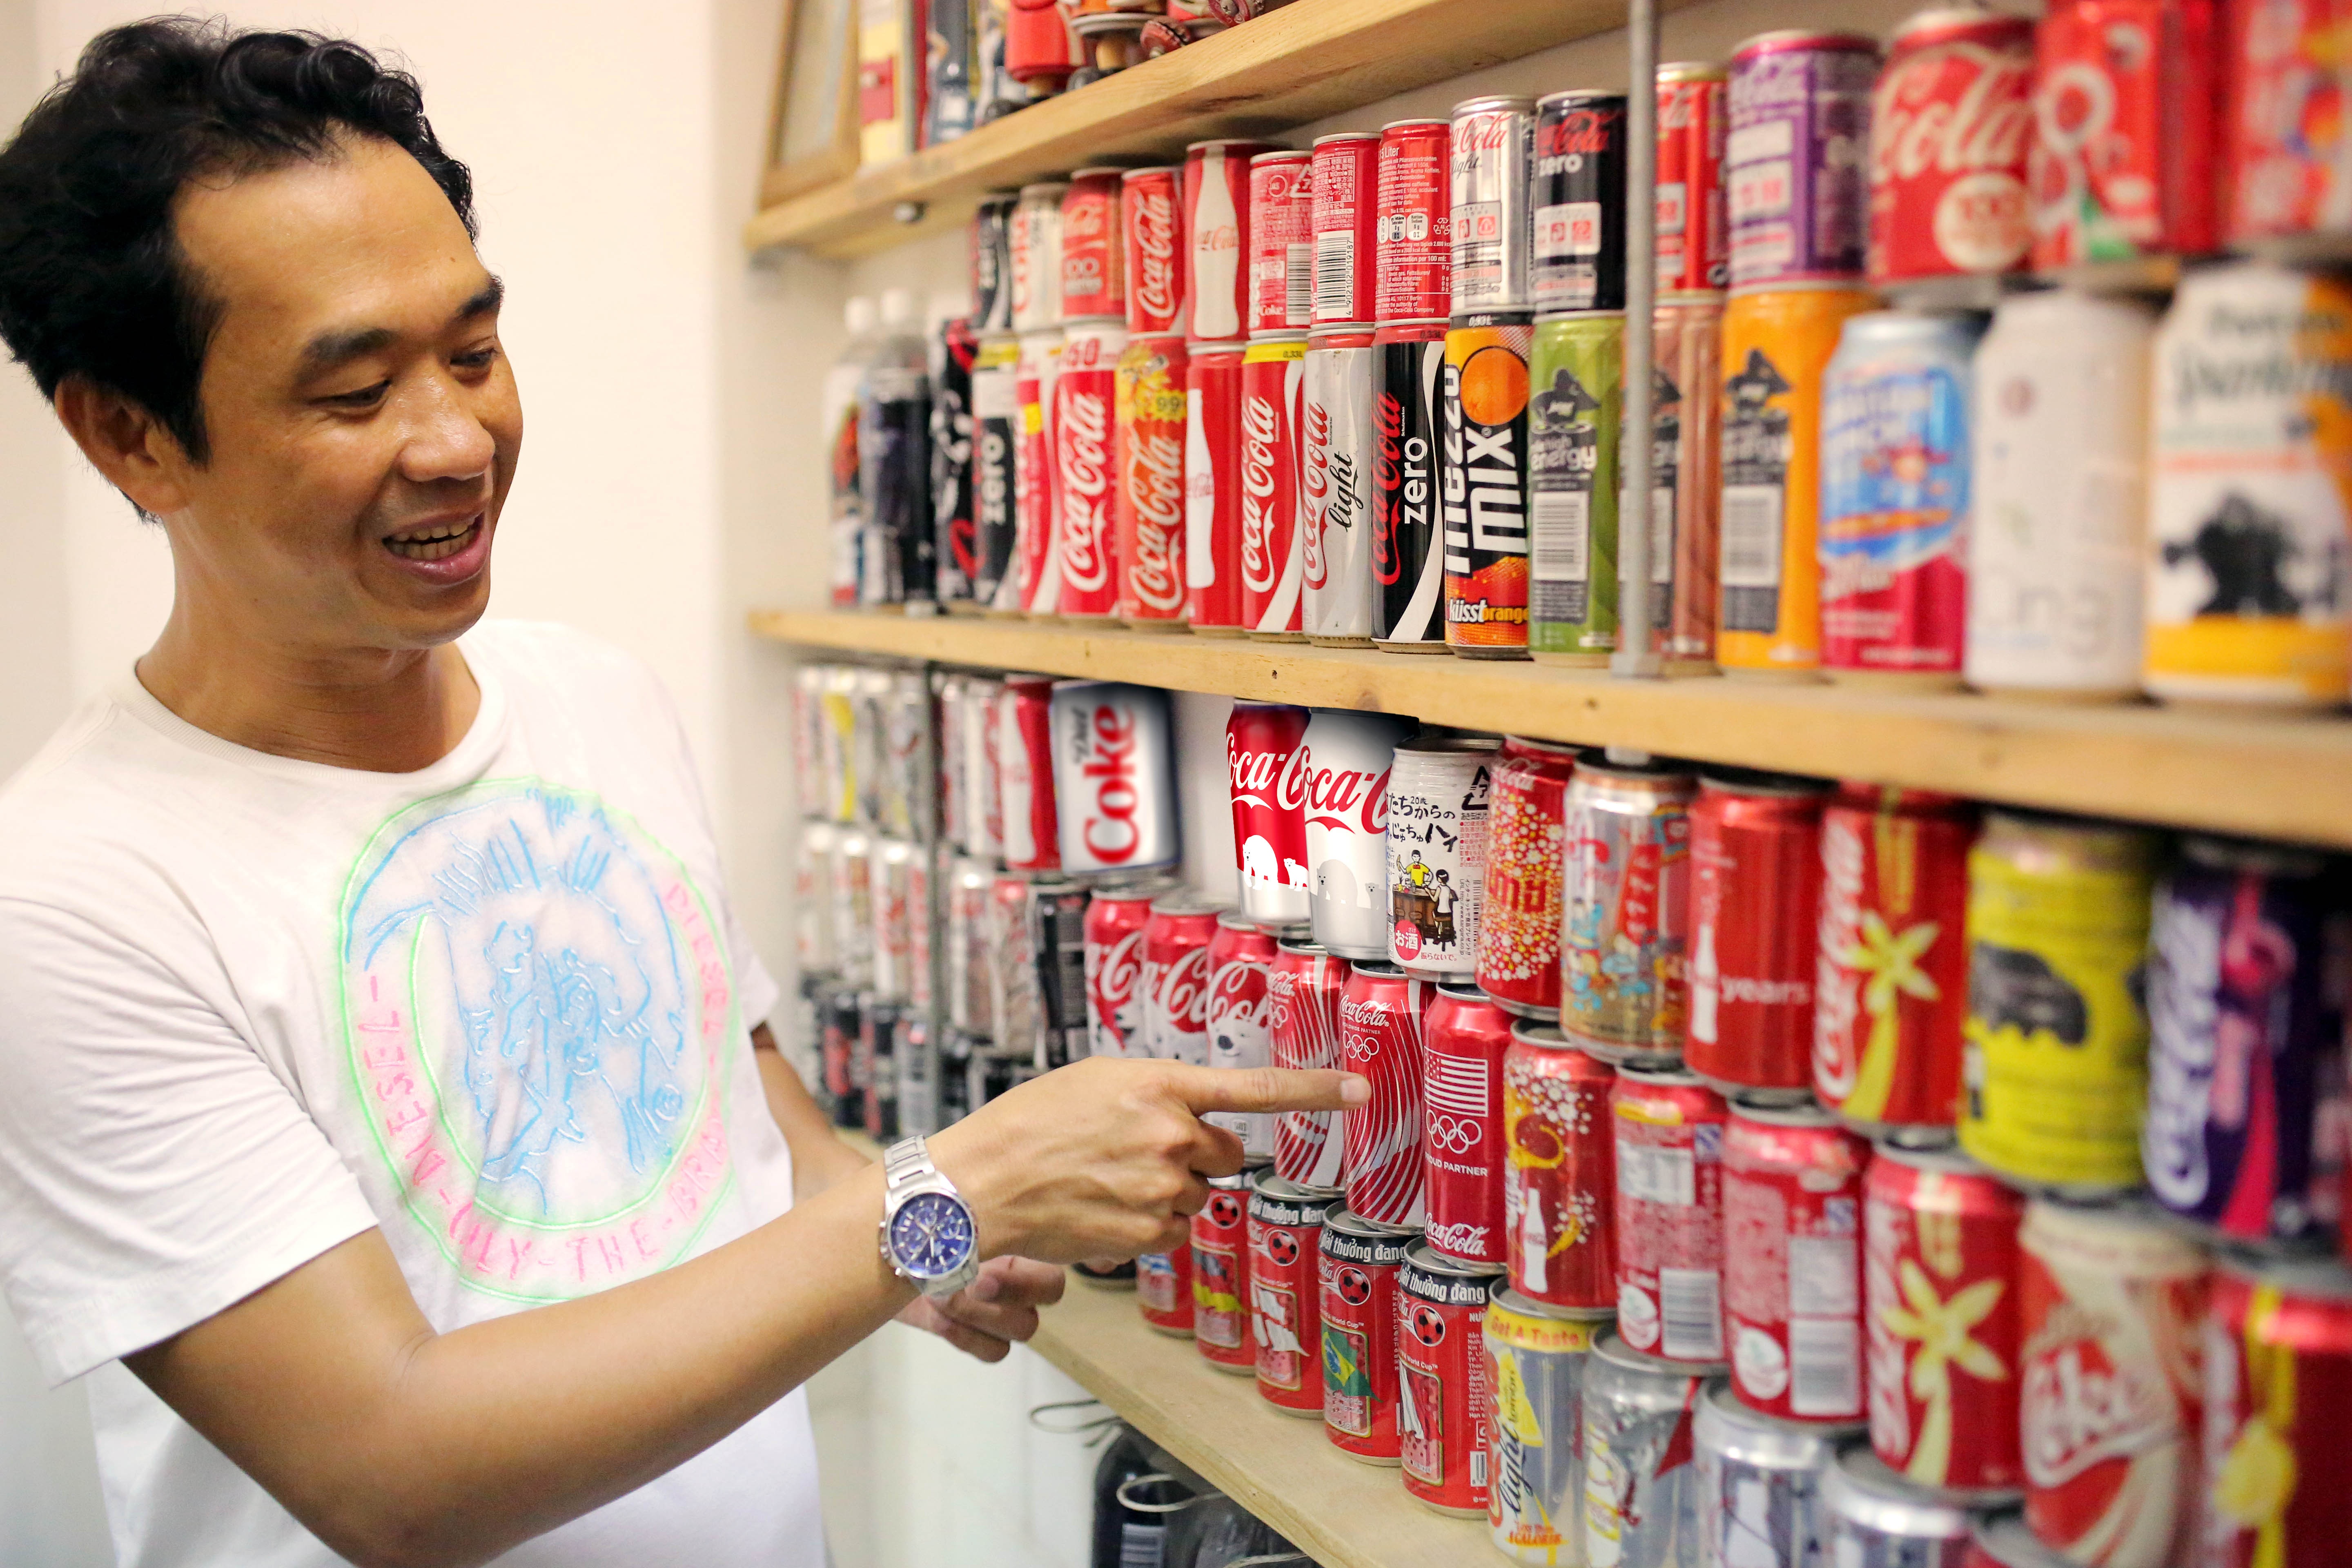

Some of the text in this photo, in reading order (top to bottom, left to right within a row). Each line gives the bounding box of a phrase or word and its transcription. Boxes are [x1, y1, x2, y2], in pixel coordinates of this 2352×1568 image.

[1385, 147, 1400, 158] Liter
[1539, 154, 1584, 177] zero
[1134, 189, 1175, 318] Coca-Cola
[1058, 382, 1107, 592] Coca-Cola
[1127, 424, 1183, 611] Coca-Cola
[1242, 394, 1275, 593] Coca-Cola
[1328, 450, 1364, 533] light
[1372, 391, 1401, 586] Coca-Cola
[1404, 437, 1428, 526] zero
[1082, 703, 1140, 865] Coke
[1226, 732, 1305, 811] Coca-C
[1300, 745, 1390, 835] Coca-C
[1395, 929, 1419, 951] お酒
[1340, 994, 1392, 1027] Coca-Cola
[1720, 977, 1811, 1005] years
[1443, 1161, 1488, 1176] PARTNER
[565, 1217, 659, 1282] THE
[1333, 1237, 1372, 1263] thưởng
[1425, 1212, 1490, 1256] Coca-Cola
[1409, 1272, 1486, 1304] thưởng đang
[1516, 1325, 1524, 1341] A
[1531, 1328, 1579, 1346] Taste
[1499, 1423, 1534, 1519] light
